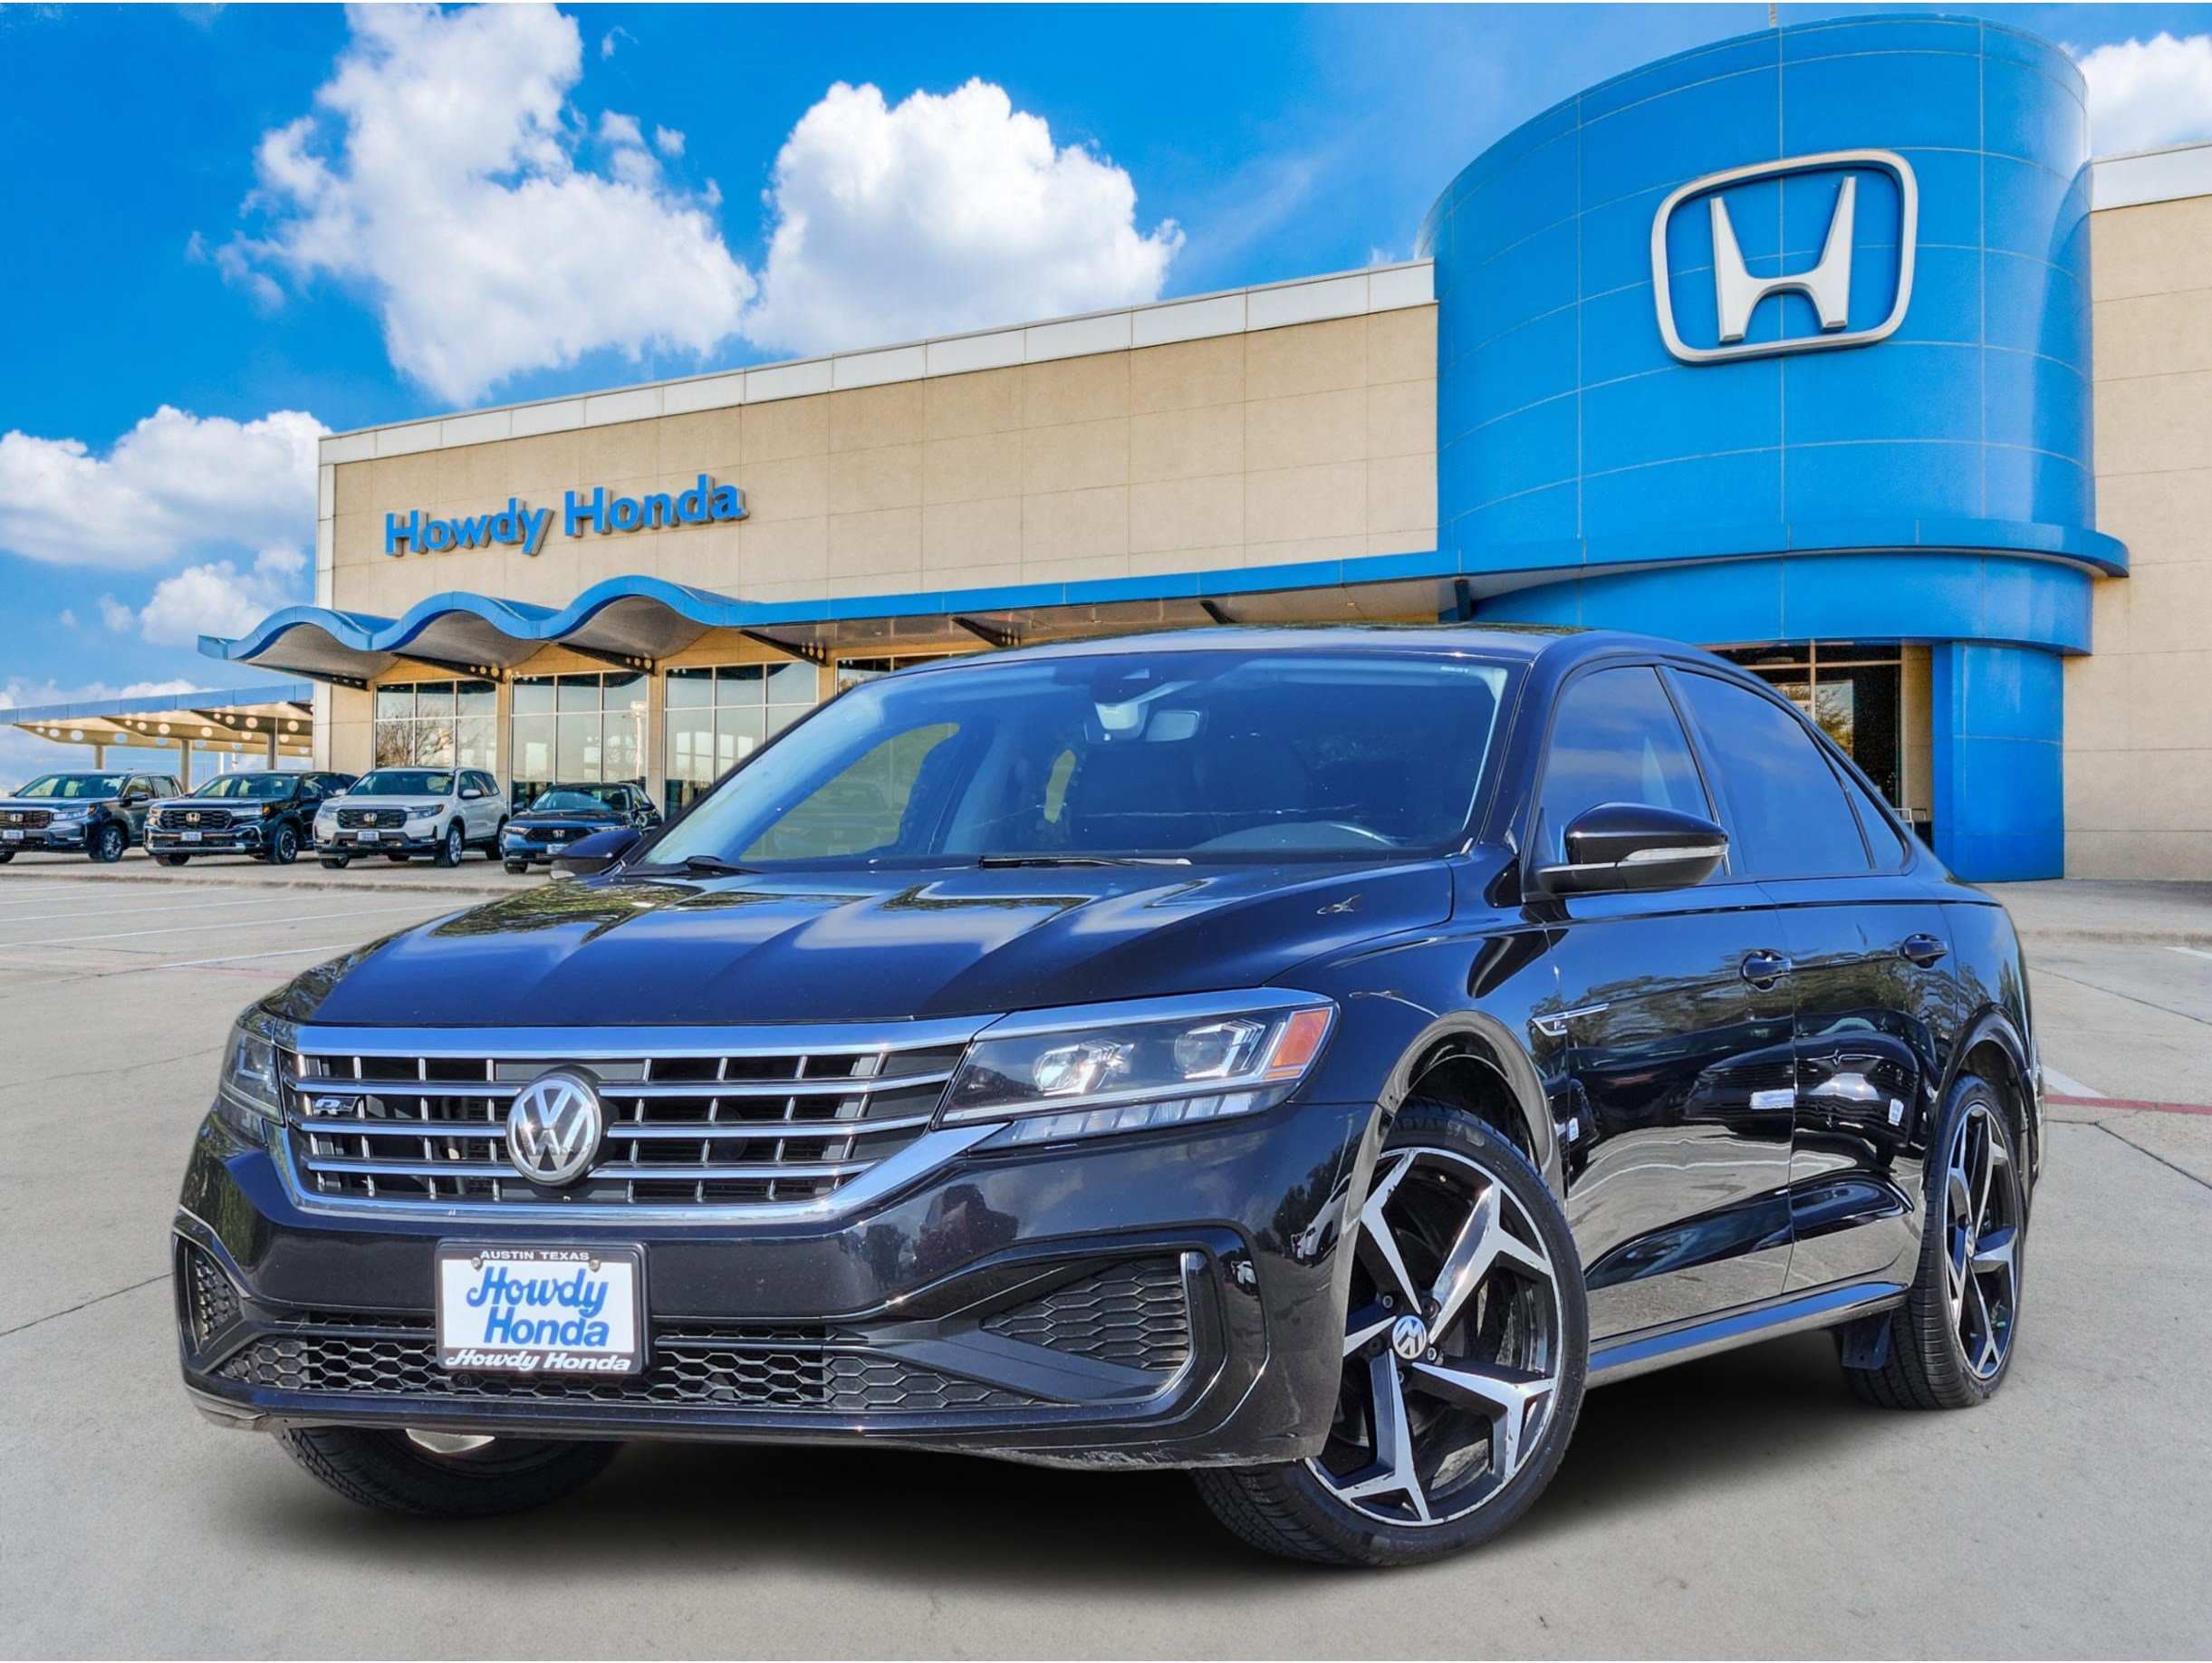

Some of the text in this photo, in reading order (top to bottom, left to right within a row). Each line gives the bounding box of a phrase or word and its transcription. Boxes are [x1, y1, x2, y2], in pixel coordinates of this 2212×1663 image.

[385, 474, 748, 556] Howdy Honda
[480, 1250, 590, 1261] AUSTIN TEXAS
[466, 1266, 610, 1319] Howdy
[483, 1306, 611, 1347] Honda
[445, 1349, 631, 1371] Howdy Honda
